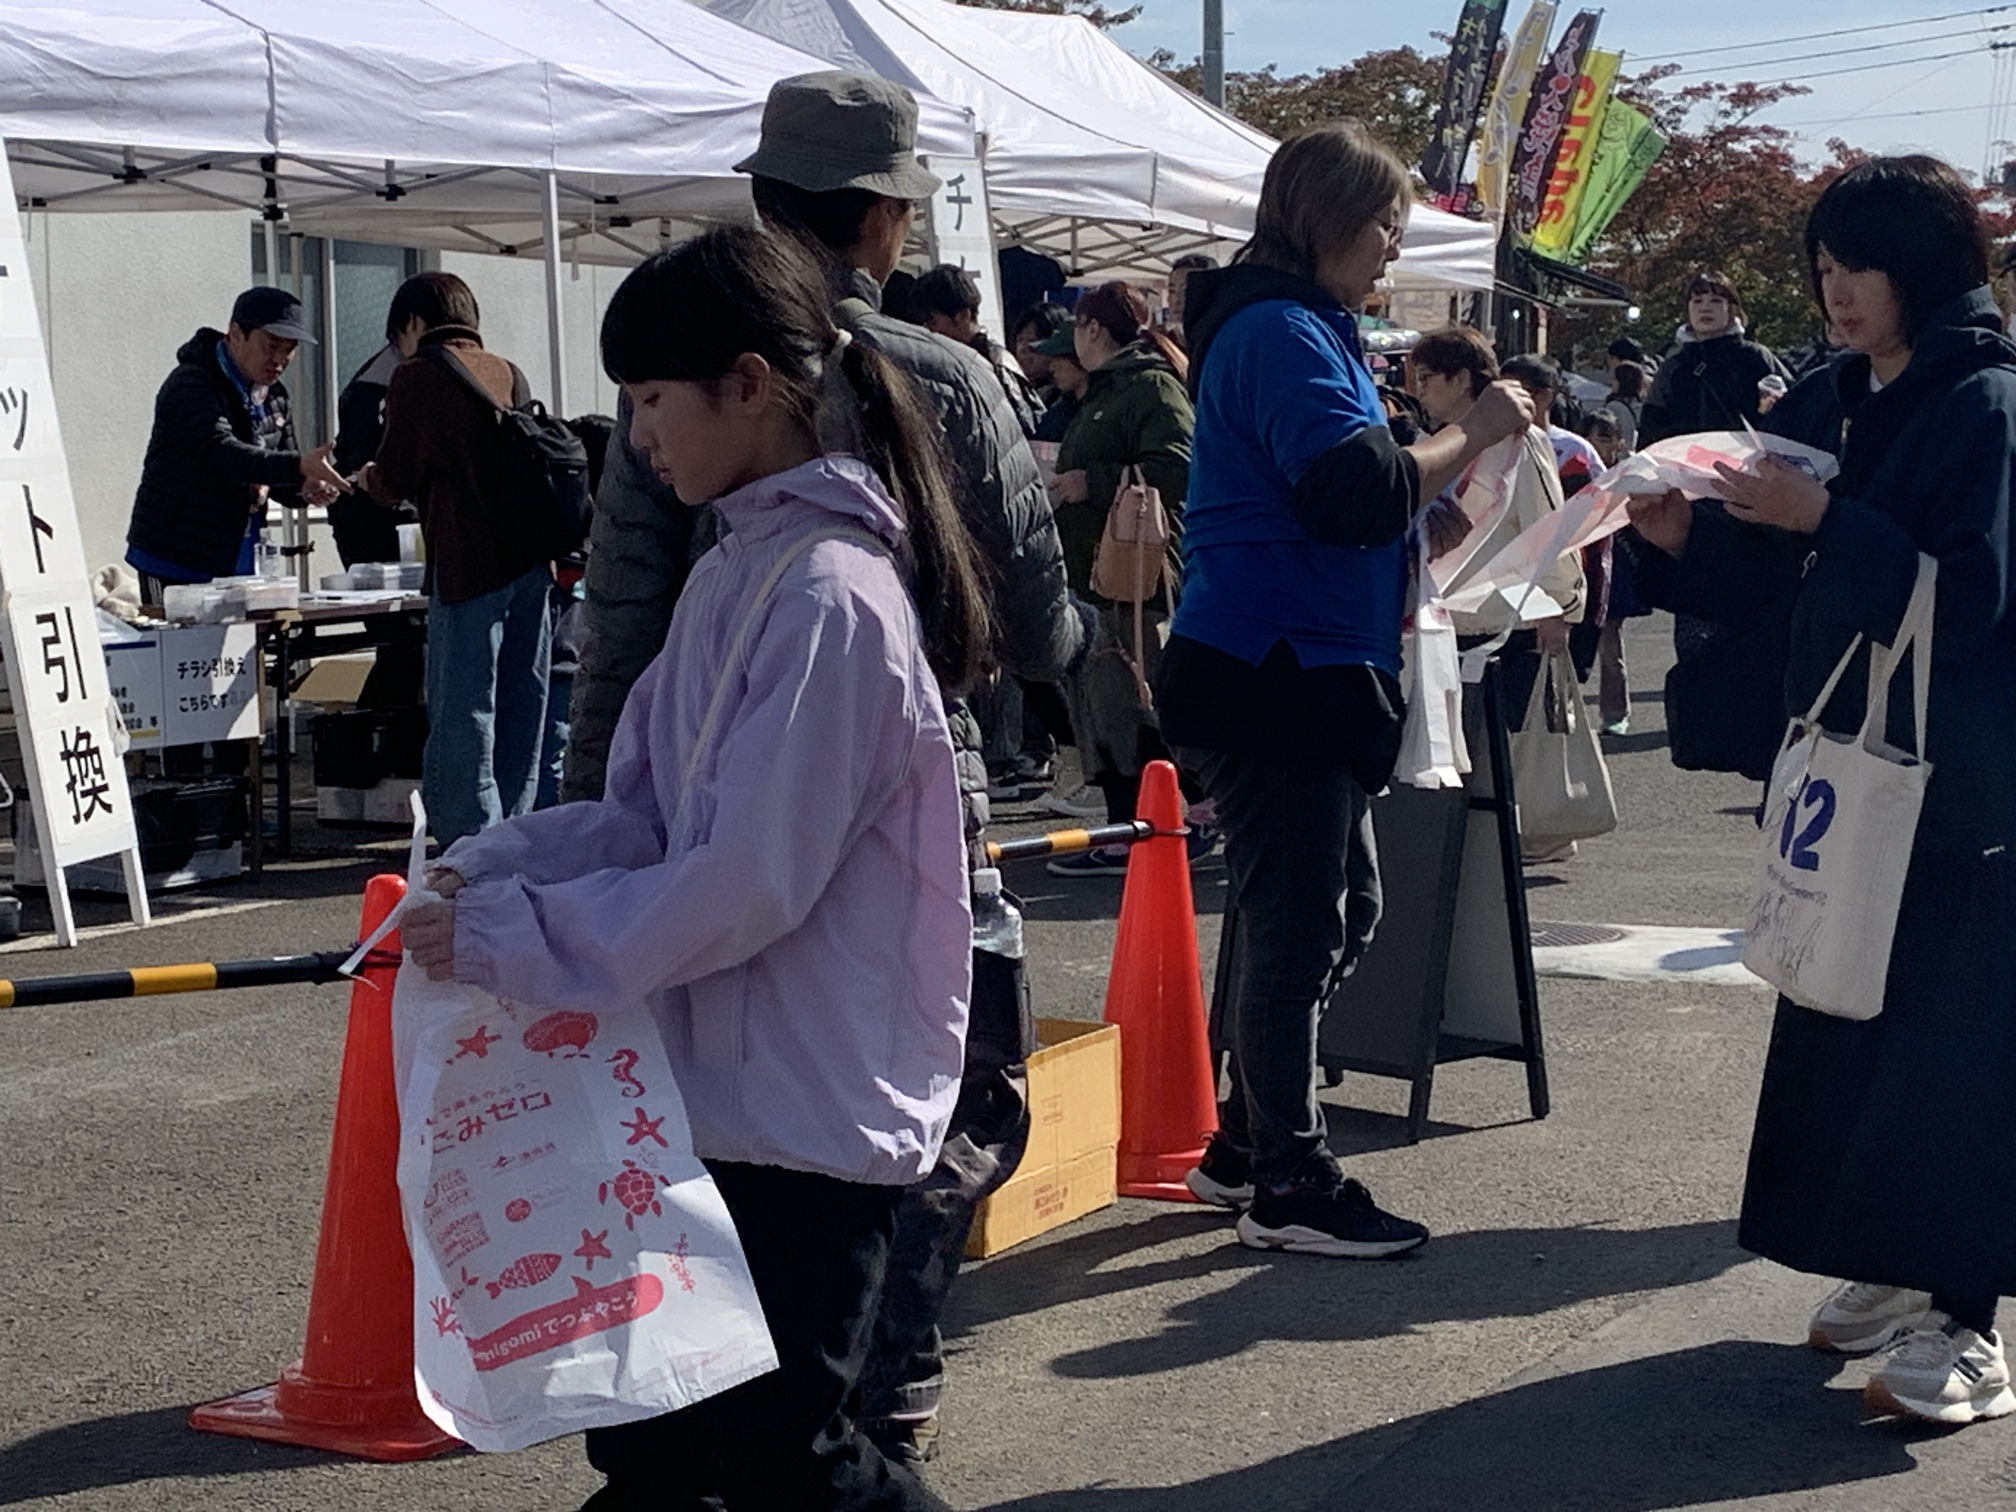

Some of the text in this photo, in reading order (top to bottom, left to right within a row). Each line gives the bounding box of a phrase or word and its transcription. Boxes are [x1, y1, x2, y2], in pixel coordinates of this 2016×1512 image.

[0, 263, 114, 825] ット引換
[177, 656, 247, 681] チラシ引換え
